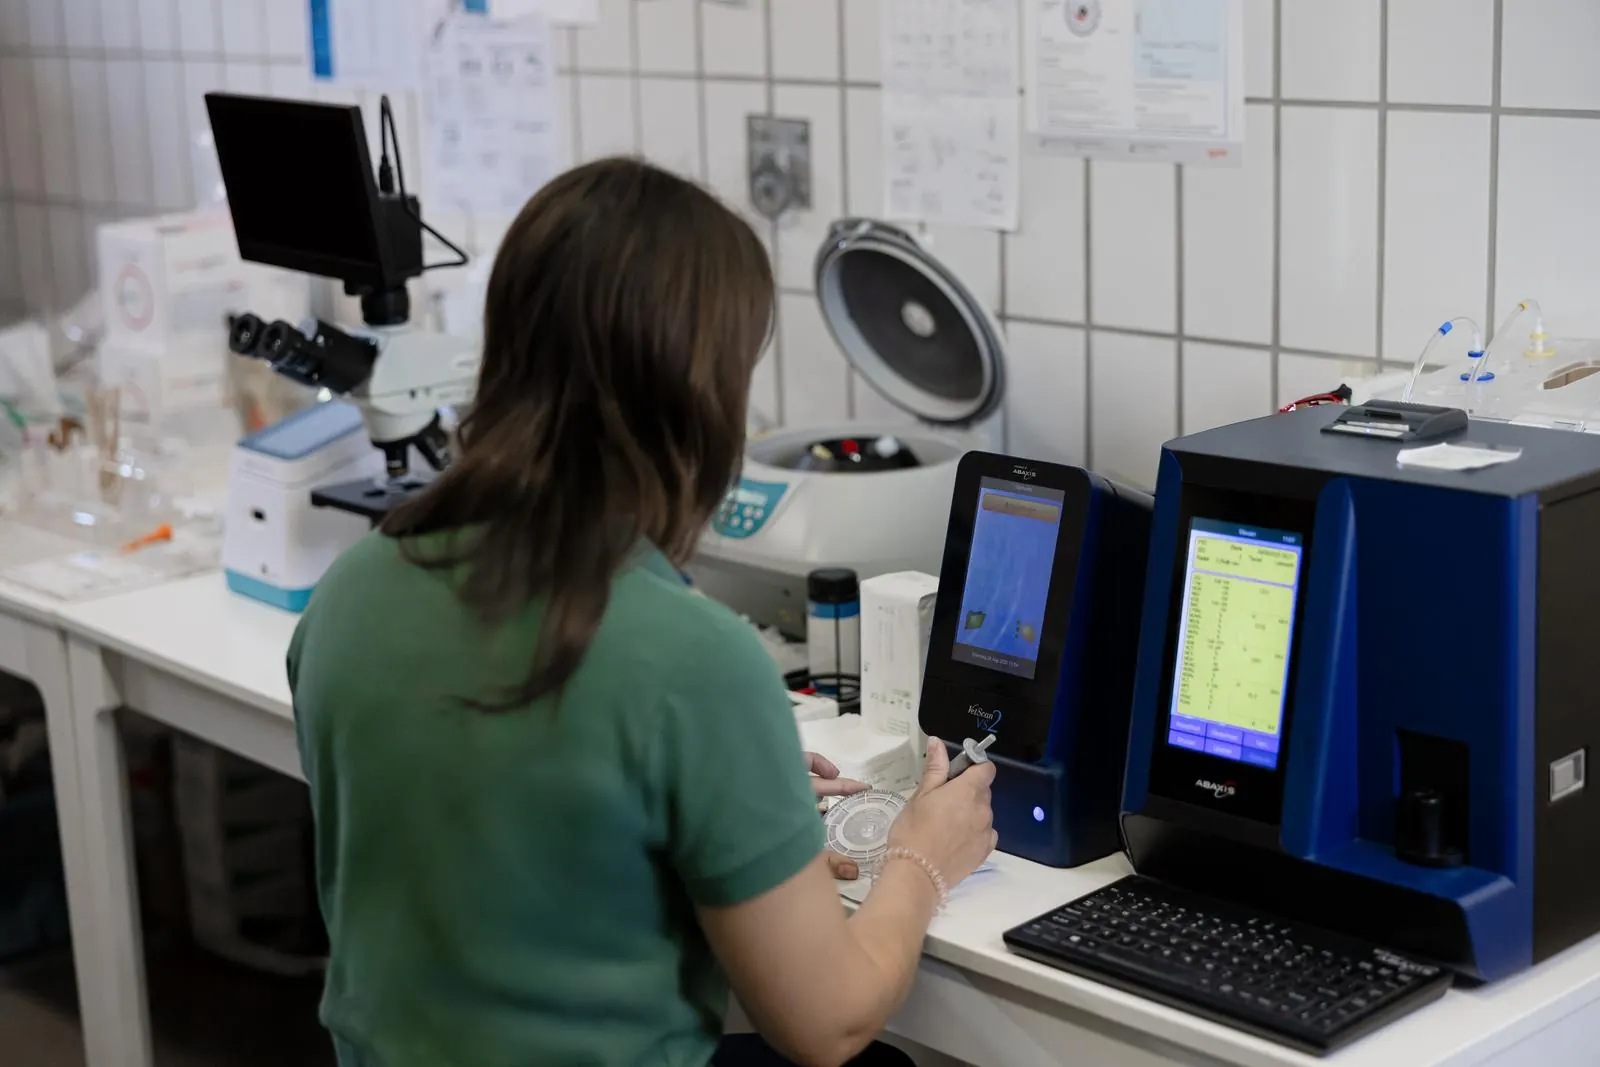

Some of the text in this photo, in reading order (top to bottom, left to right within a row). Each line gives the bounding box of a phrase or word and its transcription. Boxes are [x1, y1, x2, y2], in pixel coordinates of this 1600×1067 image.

[1012, 468, 1037, 478] ABAXIS
[967, 703, 994, 720] VetScan
[1194, 778, 1236, 797] ABAXIS
